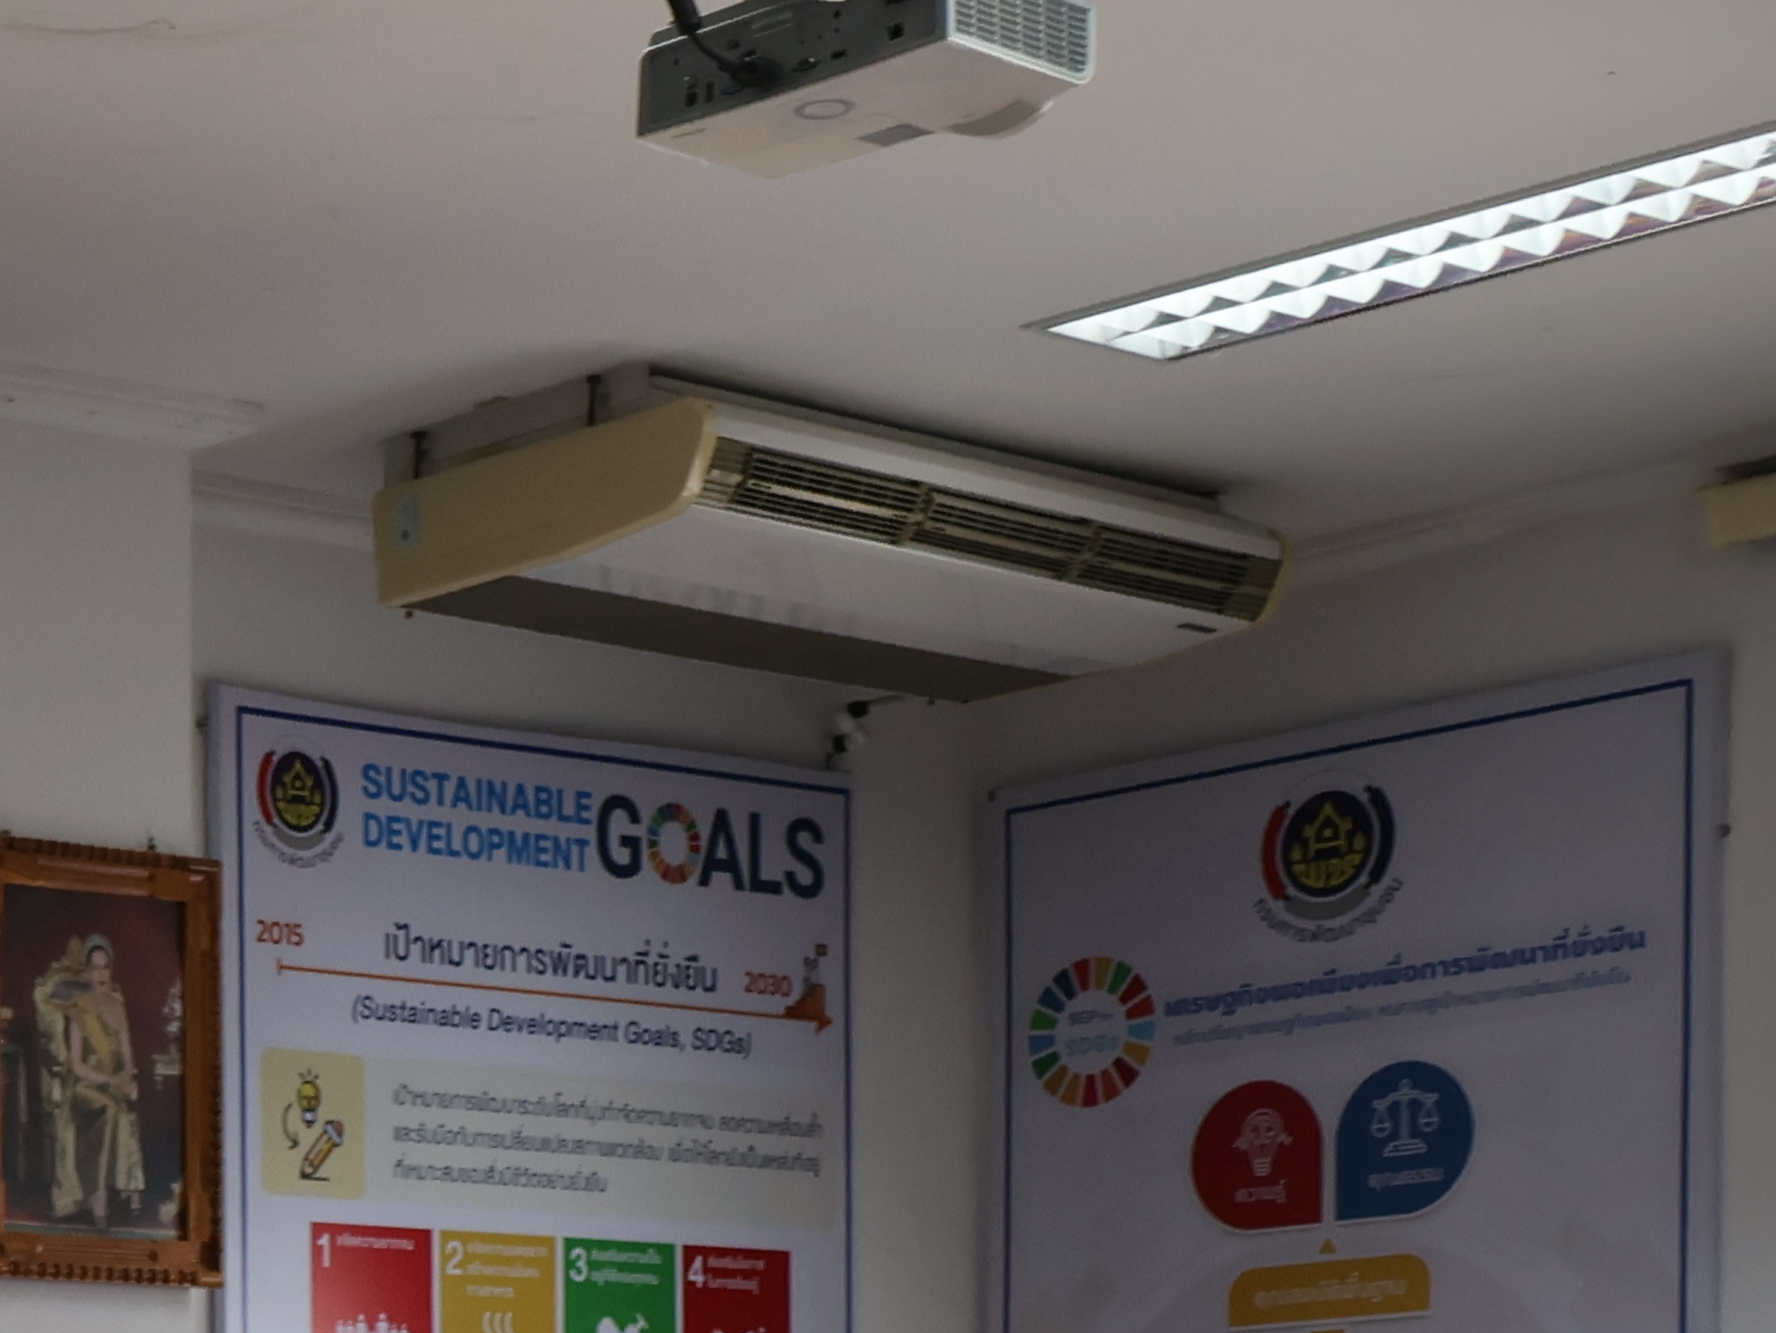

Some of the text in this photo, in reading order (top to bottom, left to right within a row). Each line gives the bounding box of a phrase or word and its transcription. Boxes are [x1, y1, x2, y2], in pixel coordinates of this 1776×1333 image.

[361, 763, 594, 827] SUSTAINABLE
[362, 813, 590, 872] DEVELOPMENT
[596, 793, 826, 899] GOALS
[255, 919, 305, 947] 2015
[384, 922, 719, 994] เป้าหมายการพัฒนาที่ยั่งยืน
[744, 970, 794, 998] 2030
[352, 994, 482, 1031] (Sustainable
[487, 1009, 620, 1047] Development
[316, 1233, 333, 1269] 1
[445, 1240, 465, 1275] 2
[569, 1247, 589, 1283] 3
[687, 1254, 706, 1289] 4
